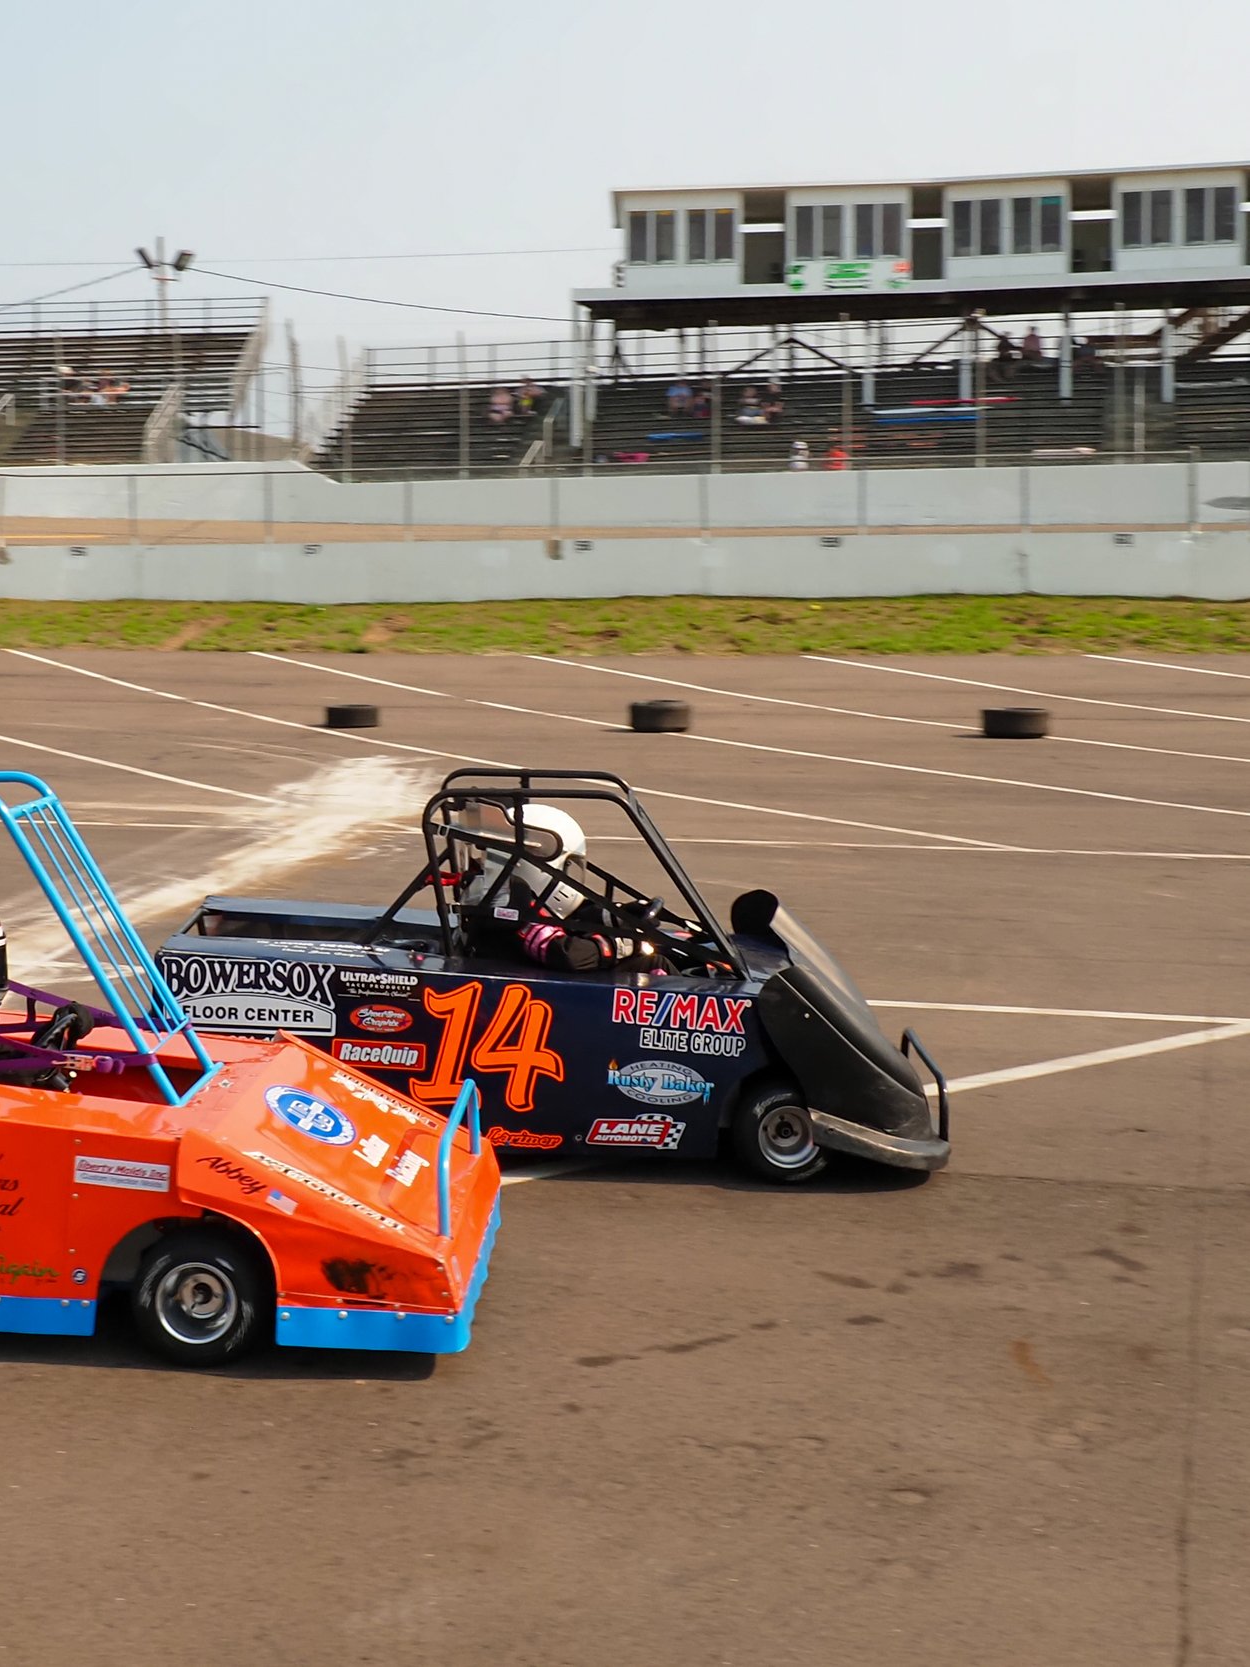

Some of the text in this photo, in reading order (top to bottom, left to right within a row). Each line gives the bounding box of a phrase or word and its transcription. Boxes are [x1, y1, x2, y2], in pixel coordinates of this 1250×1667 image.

[162, 956, 336, 1009] BOWERSOX
[182, 1004, 315, 1023] FLOOR CENTER
[613, 987, 747, 1034] RE/MAX
[339, 1042, 419, 1066] RaceQuip
[410, 981, 564, 1112] 14
[639, 1028, 747, 1058] ELITE GROUP
[630, 1062, 693, 1075] HEATING
[607, 1069, 716, 1094] Rusty Baker
[626, 1089, 694, 1103] COOLING
[598, 1122, 665, 1135] LANE
[196, 1156, 268, 1195] Abbey
